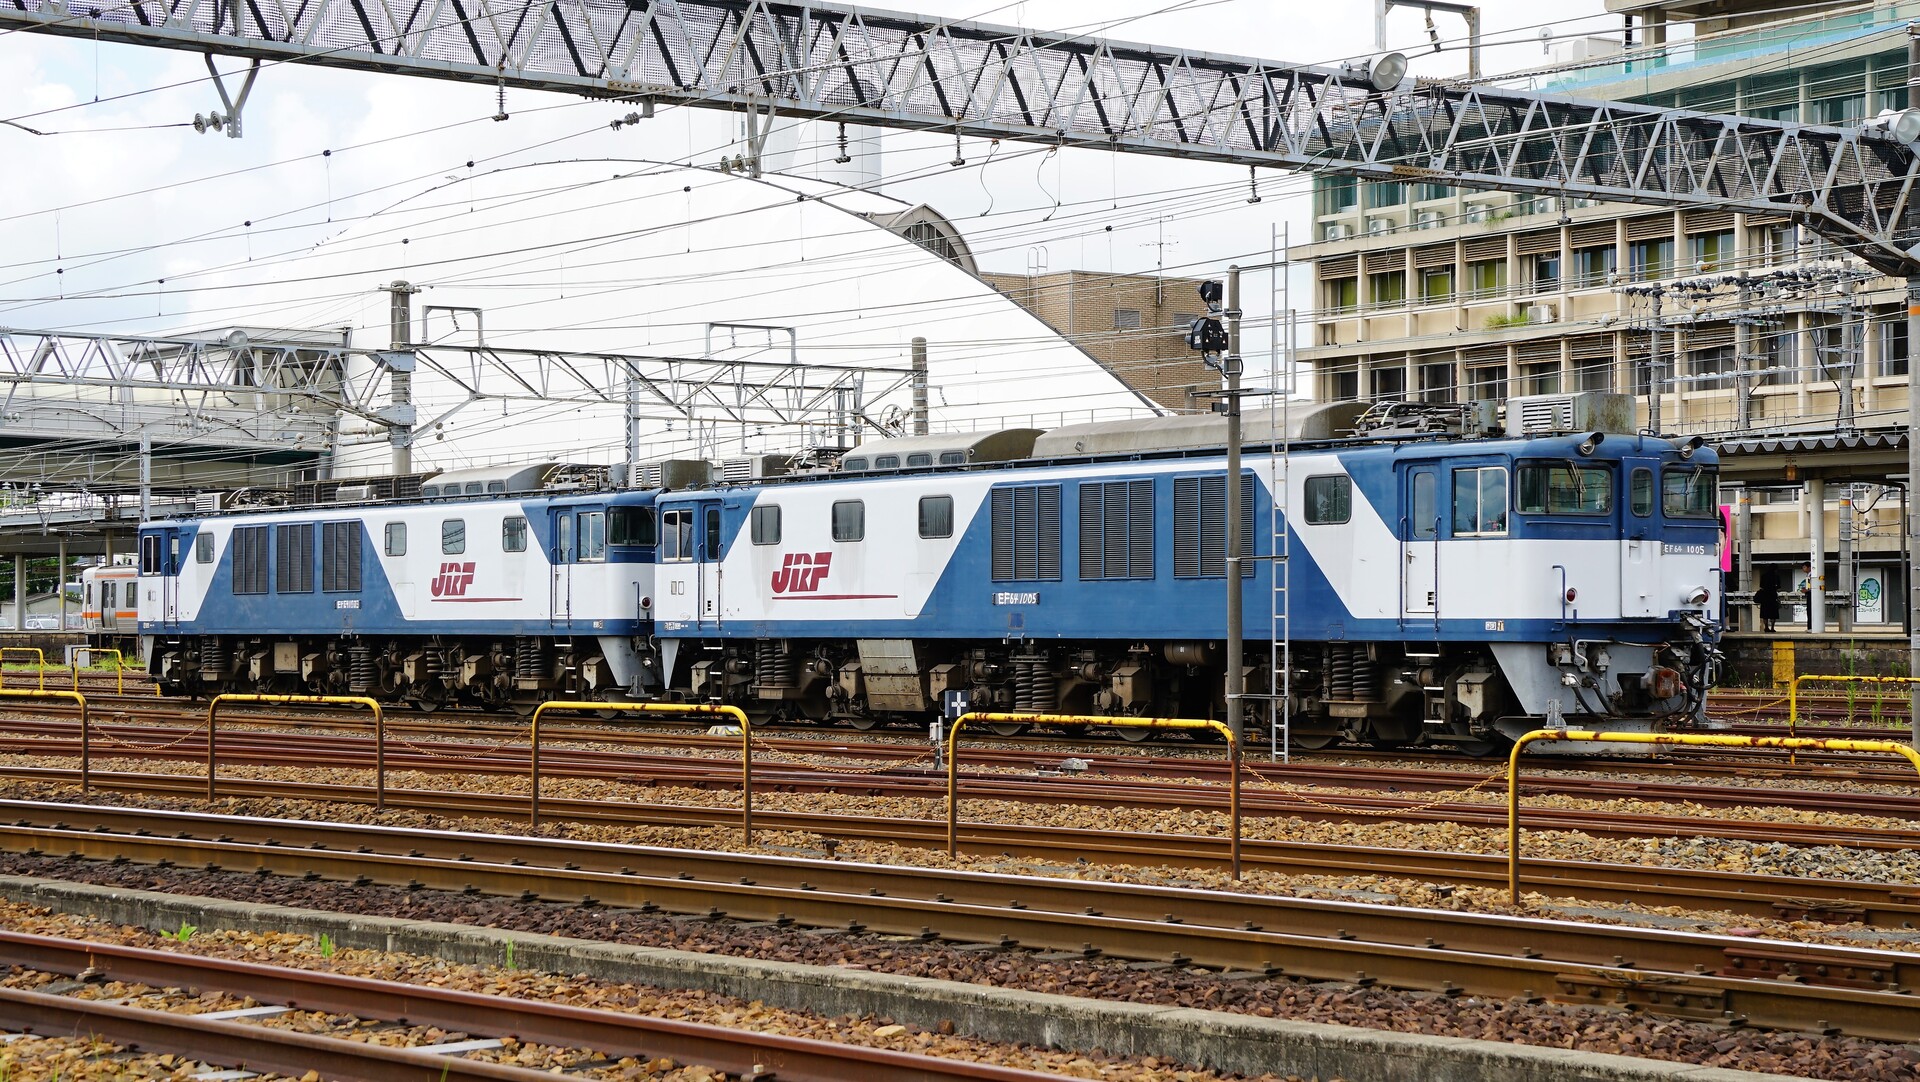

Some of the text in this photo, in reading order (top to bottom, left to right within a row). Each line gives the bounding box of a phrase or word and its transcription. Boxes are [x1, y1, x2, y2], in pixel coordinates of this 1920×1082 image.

[1664, 544, 1705, 555] EF64 1005
[431, 562, 476, 597] JRF
[770, 552, 832, 593] JRF
